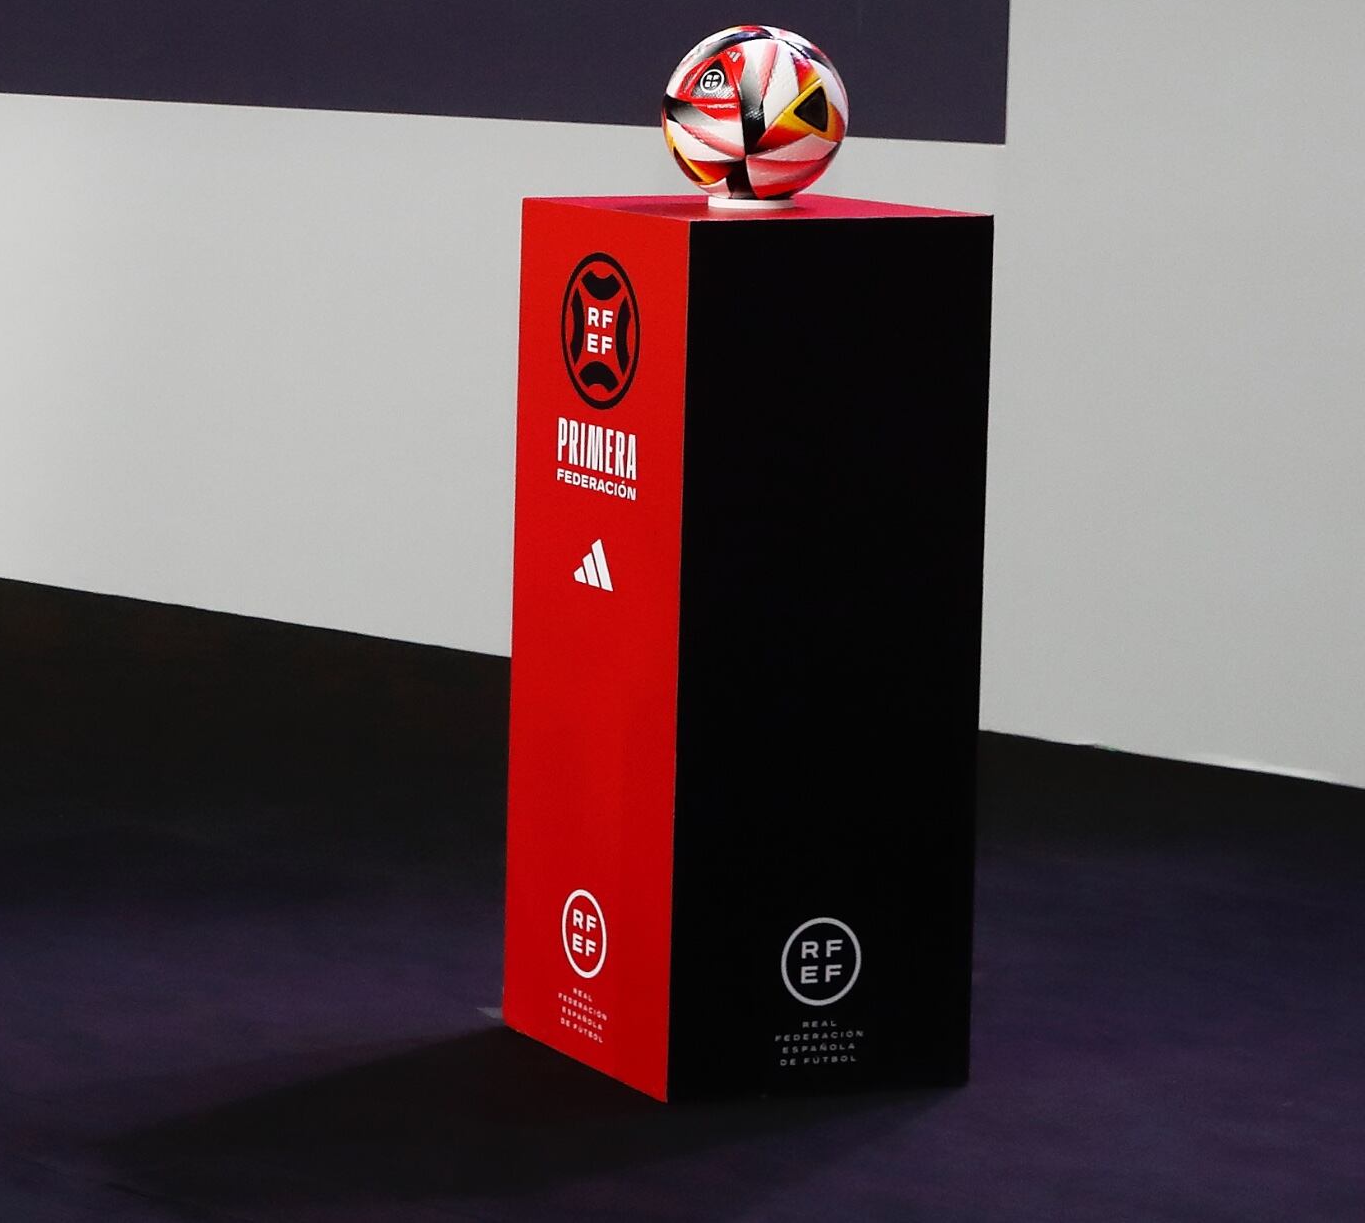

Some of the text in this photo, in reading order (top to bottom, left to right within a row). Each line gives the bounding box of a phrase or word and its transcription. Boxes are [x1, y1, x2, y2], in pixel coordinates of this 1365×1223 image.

[587, 306, 614, 329] RF
[586, 333, 613, 355] EF
[557, 416, 637, 481] PRIMERA
[556, 468, 637, 501] FEDERACIÓN
[572, 908, 597, 932] RF
[572, 932, 597, 957] EF
[801, 939, 843, 959] RF
[800, 964, 842, 984] EF
[802, 1020, 837, 1029] REAL
[780, 1058, 797, 1067] DE
